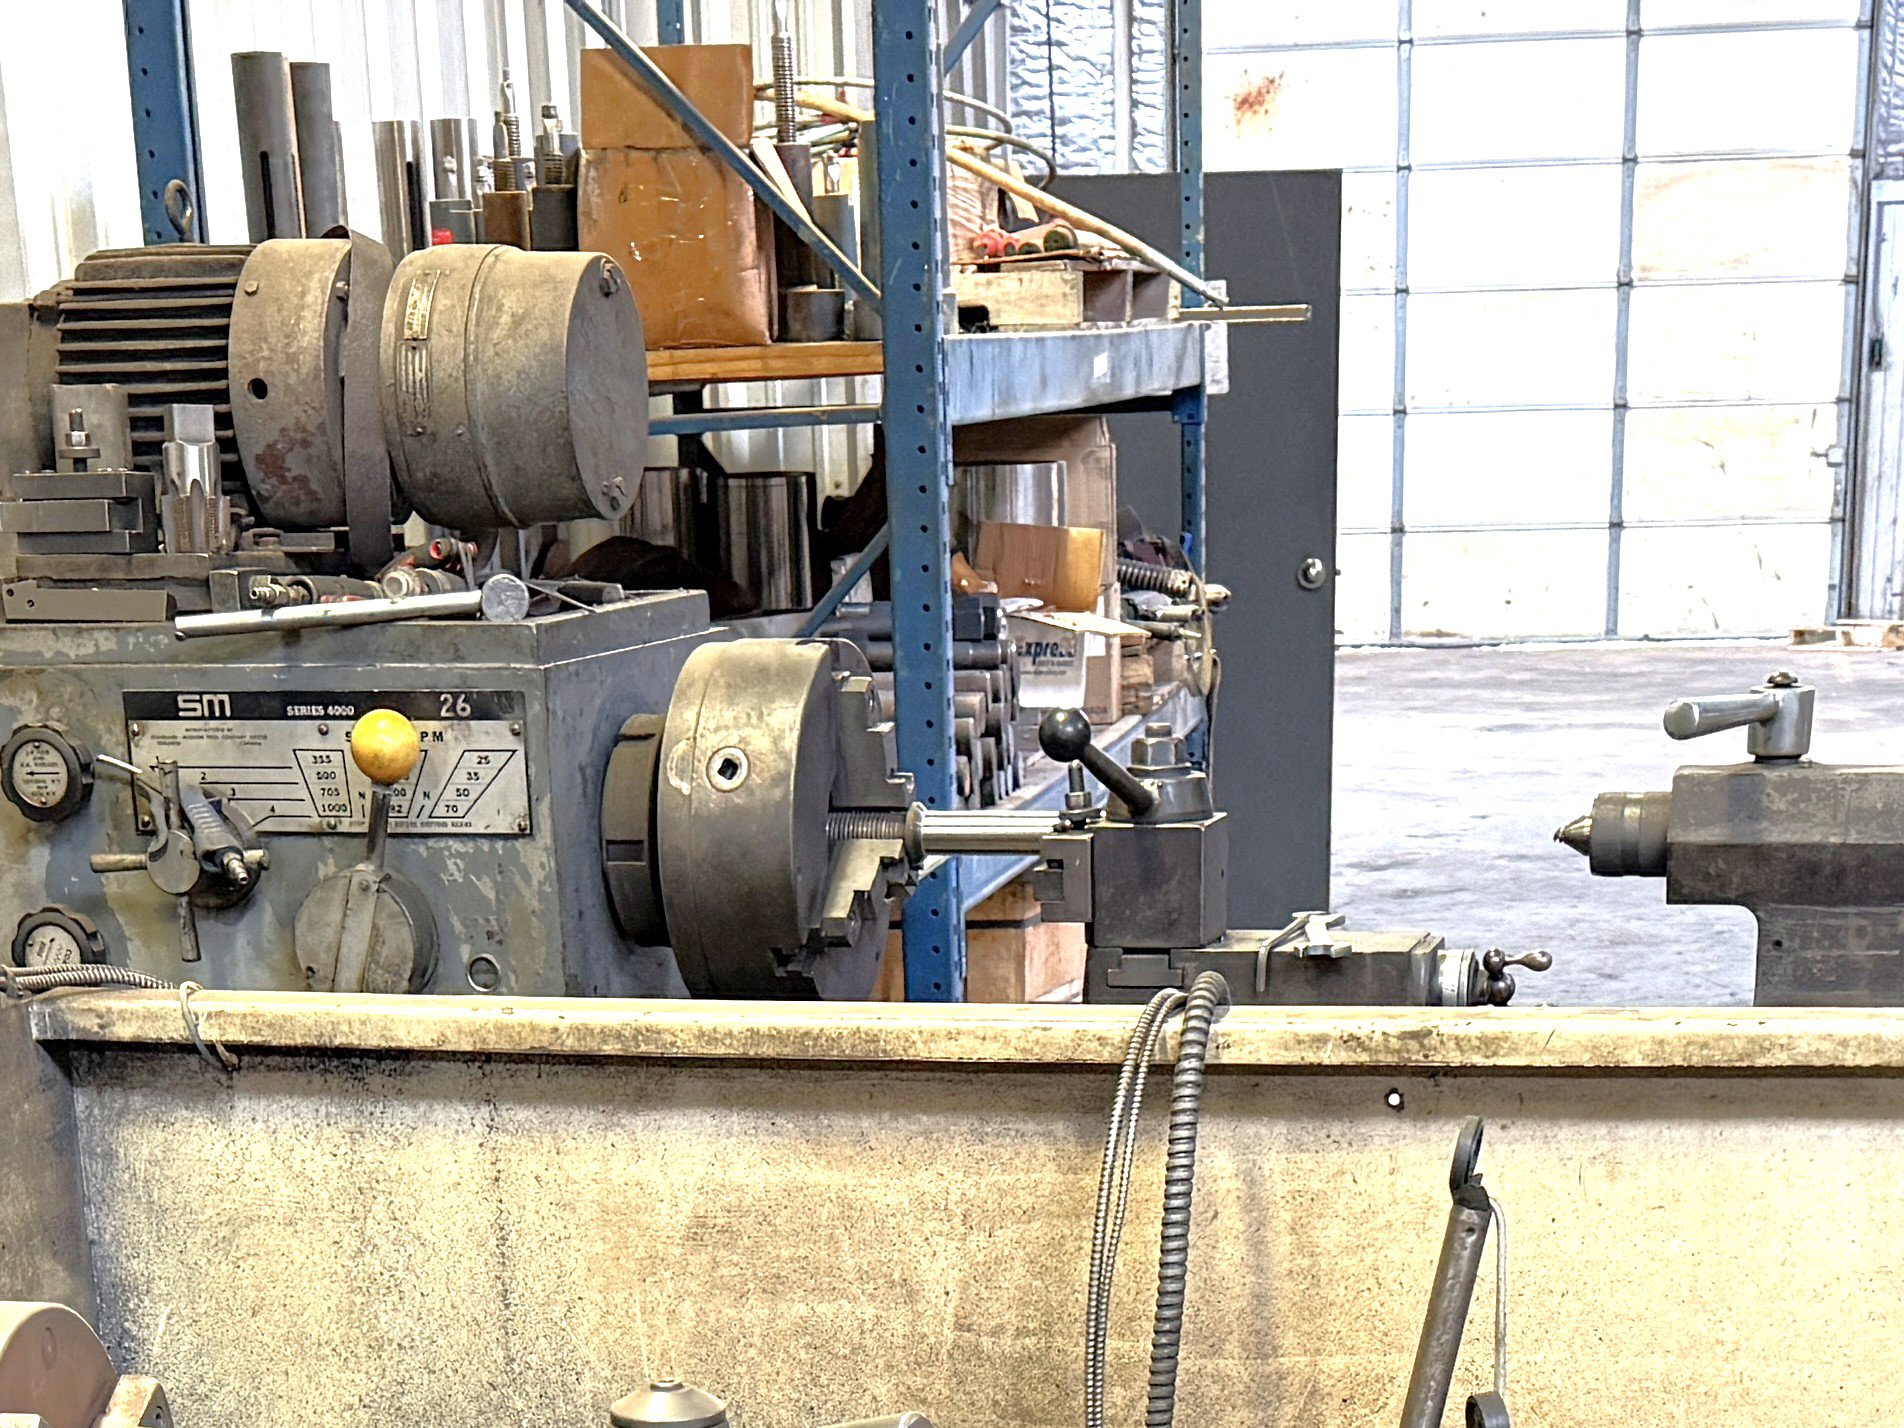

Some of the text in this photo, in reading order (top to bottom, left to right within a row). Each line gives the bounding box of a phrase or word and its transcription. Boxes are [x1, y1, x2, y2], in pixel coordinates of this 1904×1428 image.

[287, 705, 355, 716] SERIES 4000
[440, 694, 471, 718] 26
[476, 755, 491, 765] 25
[200, 771, 480, 781] 2 500 35
[320, 787, 340, 796] 705
[456, 788, 470, 797] 50
[321, 804, 348, 813] 1000
[444, 804, 458, 813] 70
